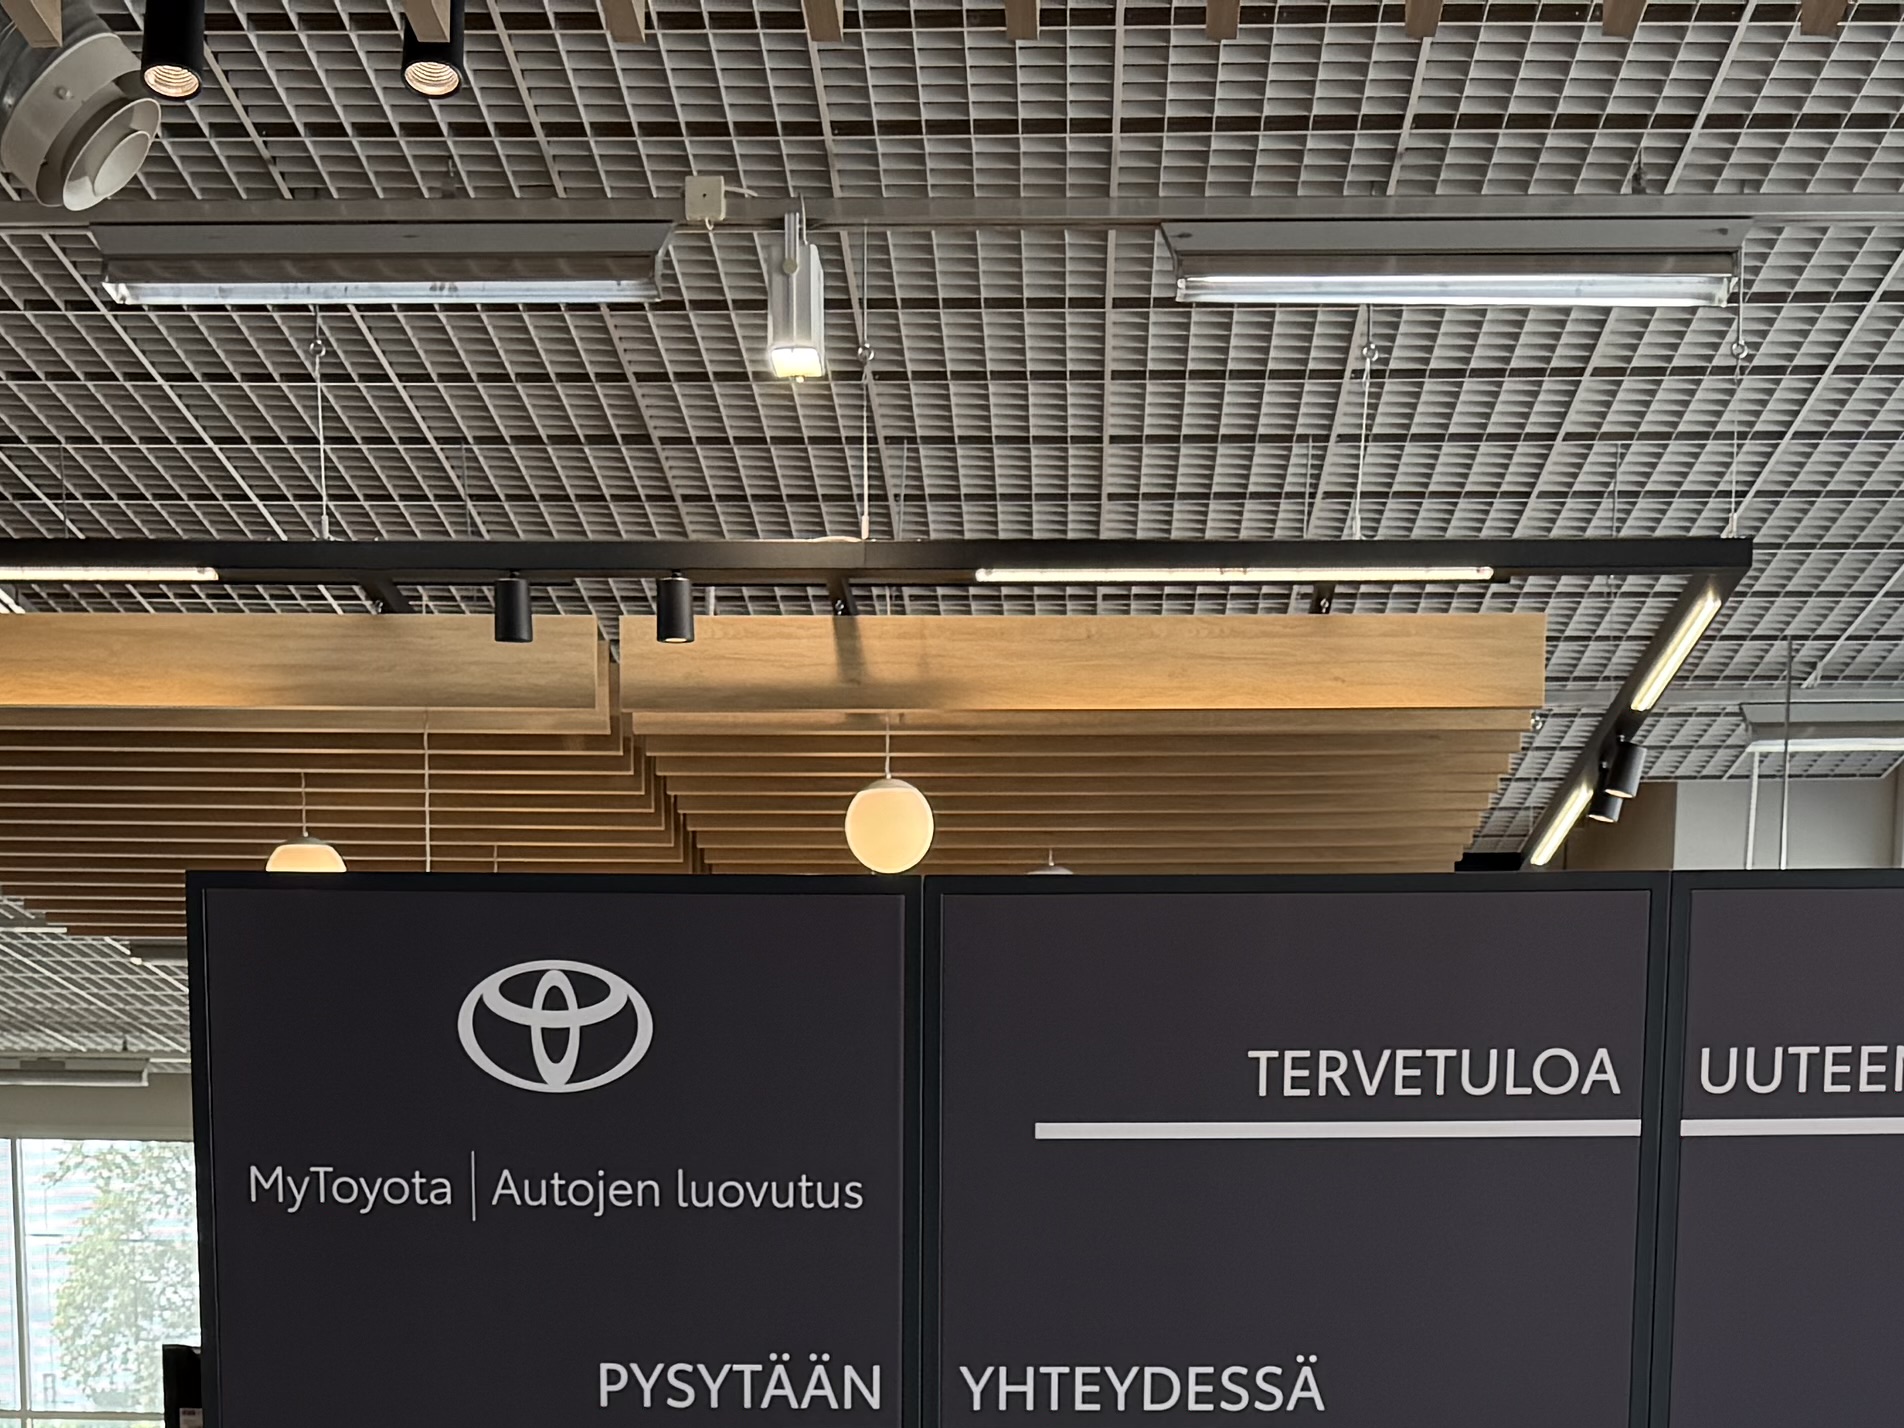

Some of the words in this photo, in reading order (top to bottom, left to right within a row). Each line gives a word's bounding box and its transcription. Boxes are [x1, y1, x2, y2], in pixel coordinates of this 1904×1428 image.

[1247, 1047, 1621, 1097] TERVETULOA
[250, 1165, 452, 1214] MyToyota
[491, 1168, 660, 1217] Autojen
[678, 1168, 863, 1209] luovutus
[599, 1352, 881, 1410] PYSYTÄÄN
[959, 1354, 1325, 1412] YHTEYDESSÄ
